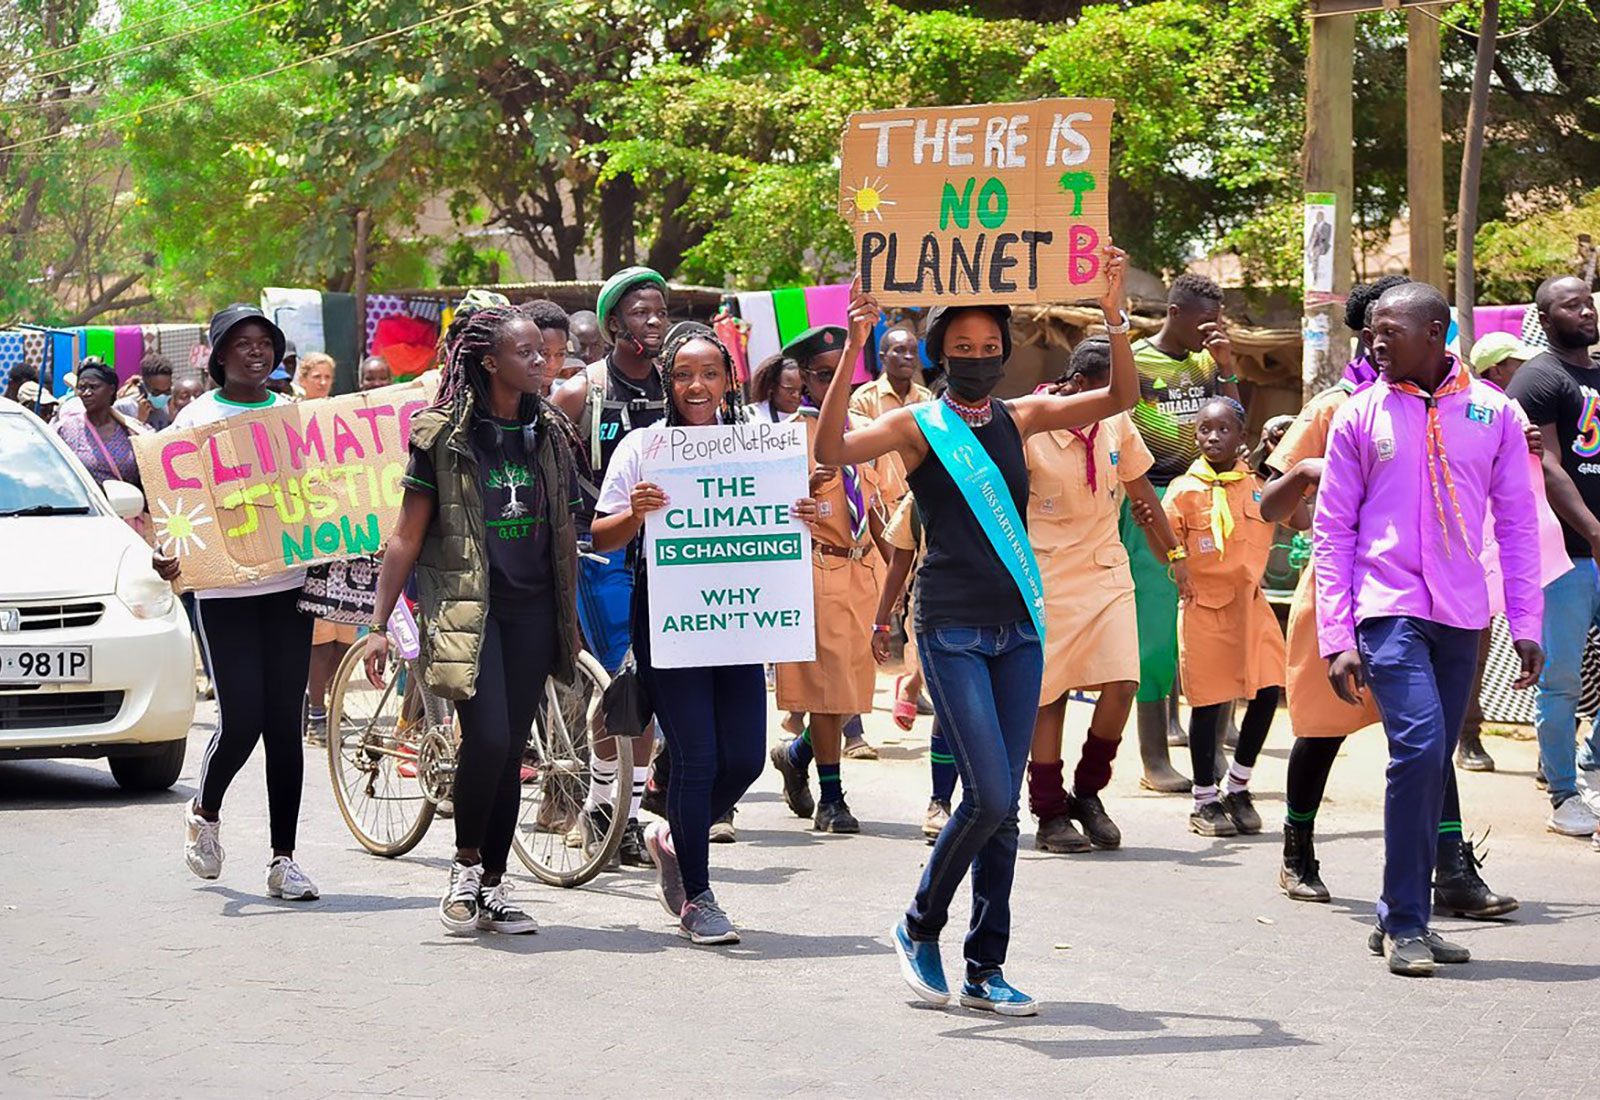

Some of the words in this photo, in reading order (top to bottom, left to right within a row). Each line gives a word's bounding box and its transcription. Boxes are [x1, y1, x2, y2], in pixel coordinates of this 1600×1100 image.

[859, 115, 1029, 168] THERE
[1045, 112, 1093, 167] IS
[940, 177, 1009, 231] NO
[861, 230, 1053, 294] PLANET
[1068, 224, 1100, 285] B
[697, 477, 755, 498] THE
[665, 505, 790, 529] CLIMATE
[980, 480, 999, 508] MISS
[993, 504, 1016, 542] EARTH
[1011, 538, 1030, 576] KENYA
[282, 513, 380, 565] NOW
[659, 545, 677, 560] IS
[682, 540, 798, 559] CHANGING!
[700, 588, 760, 606] WHY
[662, 612, 749, 633] AREN'T
[753, 610, 801, 628] WE?
[18, 652, 86, 677] 981P
